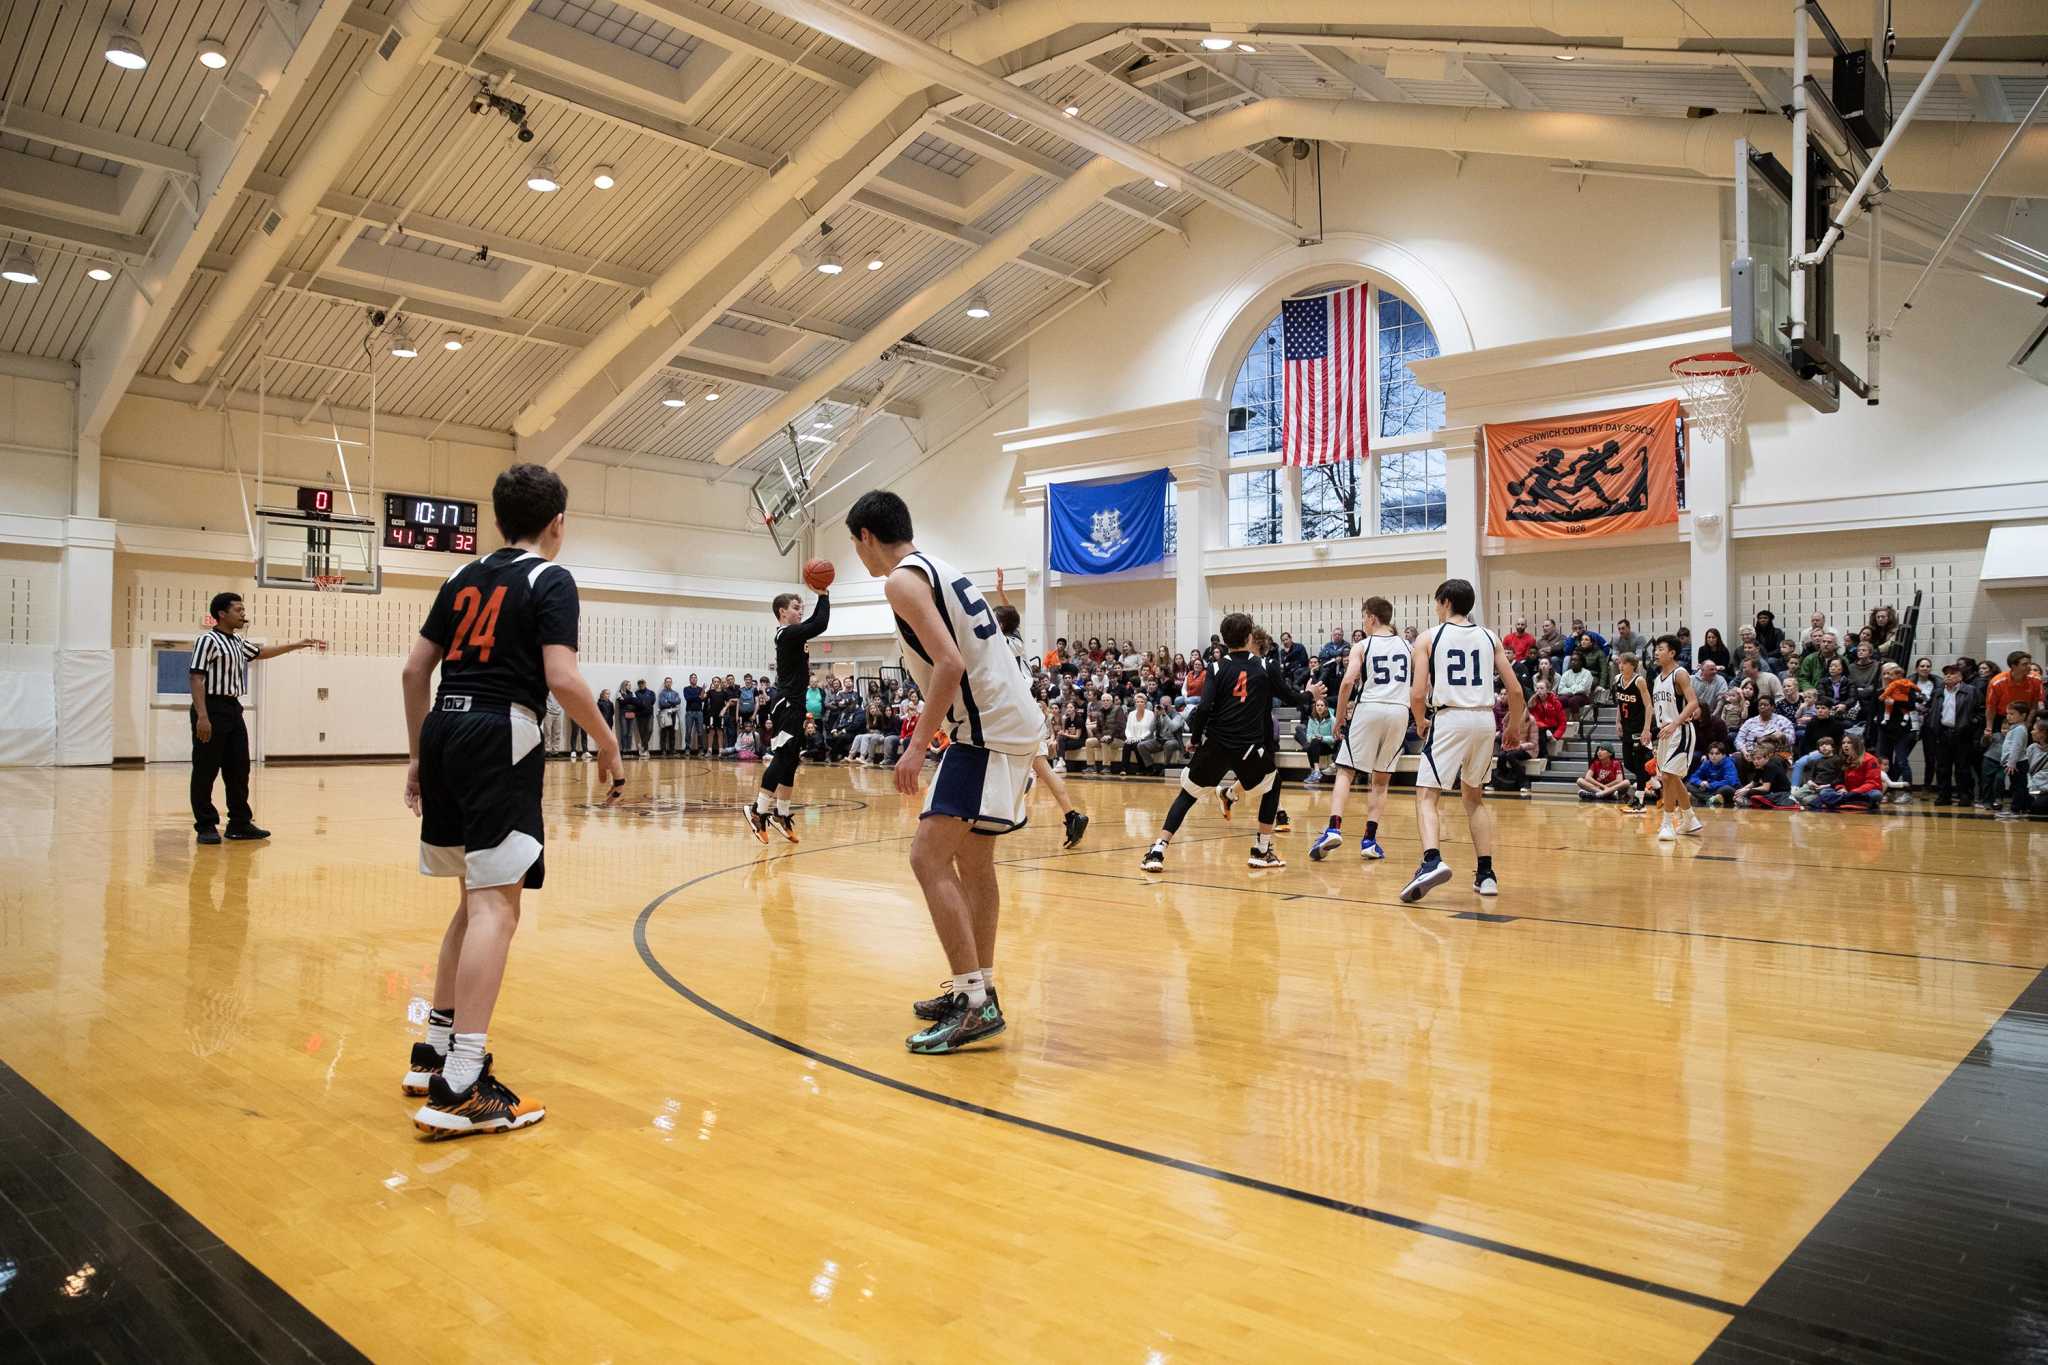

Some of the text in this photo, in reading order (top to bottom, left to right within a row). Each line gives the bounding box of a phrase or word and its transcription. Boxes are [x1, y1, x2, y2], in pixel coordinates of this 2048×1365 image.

[1512, 428, 1560, 448] GREENWICH
[1562, 423, 1605, 436] COUNTRY
[1605, 423, 1623, 432] DAY
[1624, 424, 1655, 437] SCHOOL
[316, 491, 328, 509] 0
[415, 502, 459, 525] 10:17
[393, 529, 413, 544] 41
[426, 535, 435, 547] 2
[1566, 524, 1586, 535] 1926
[455, 534, 474, 550] 32
[446, 586, 508, 662] 24
[1372, 653, 1408, 685] 53
[1447, 648, 1483, 686] 21
[1232, 671, 1248, 703] 4
